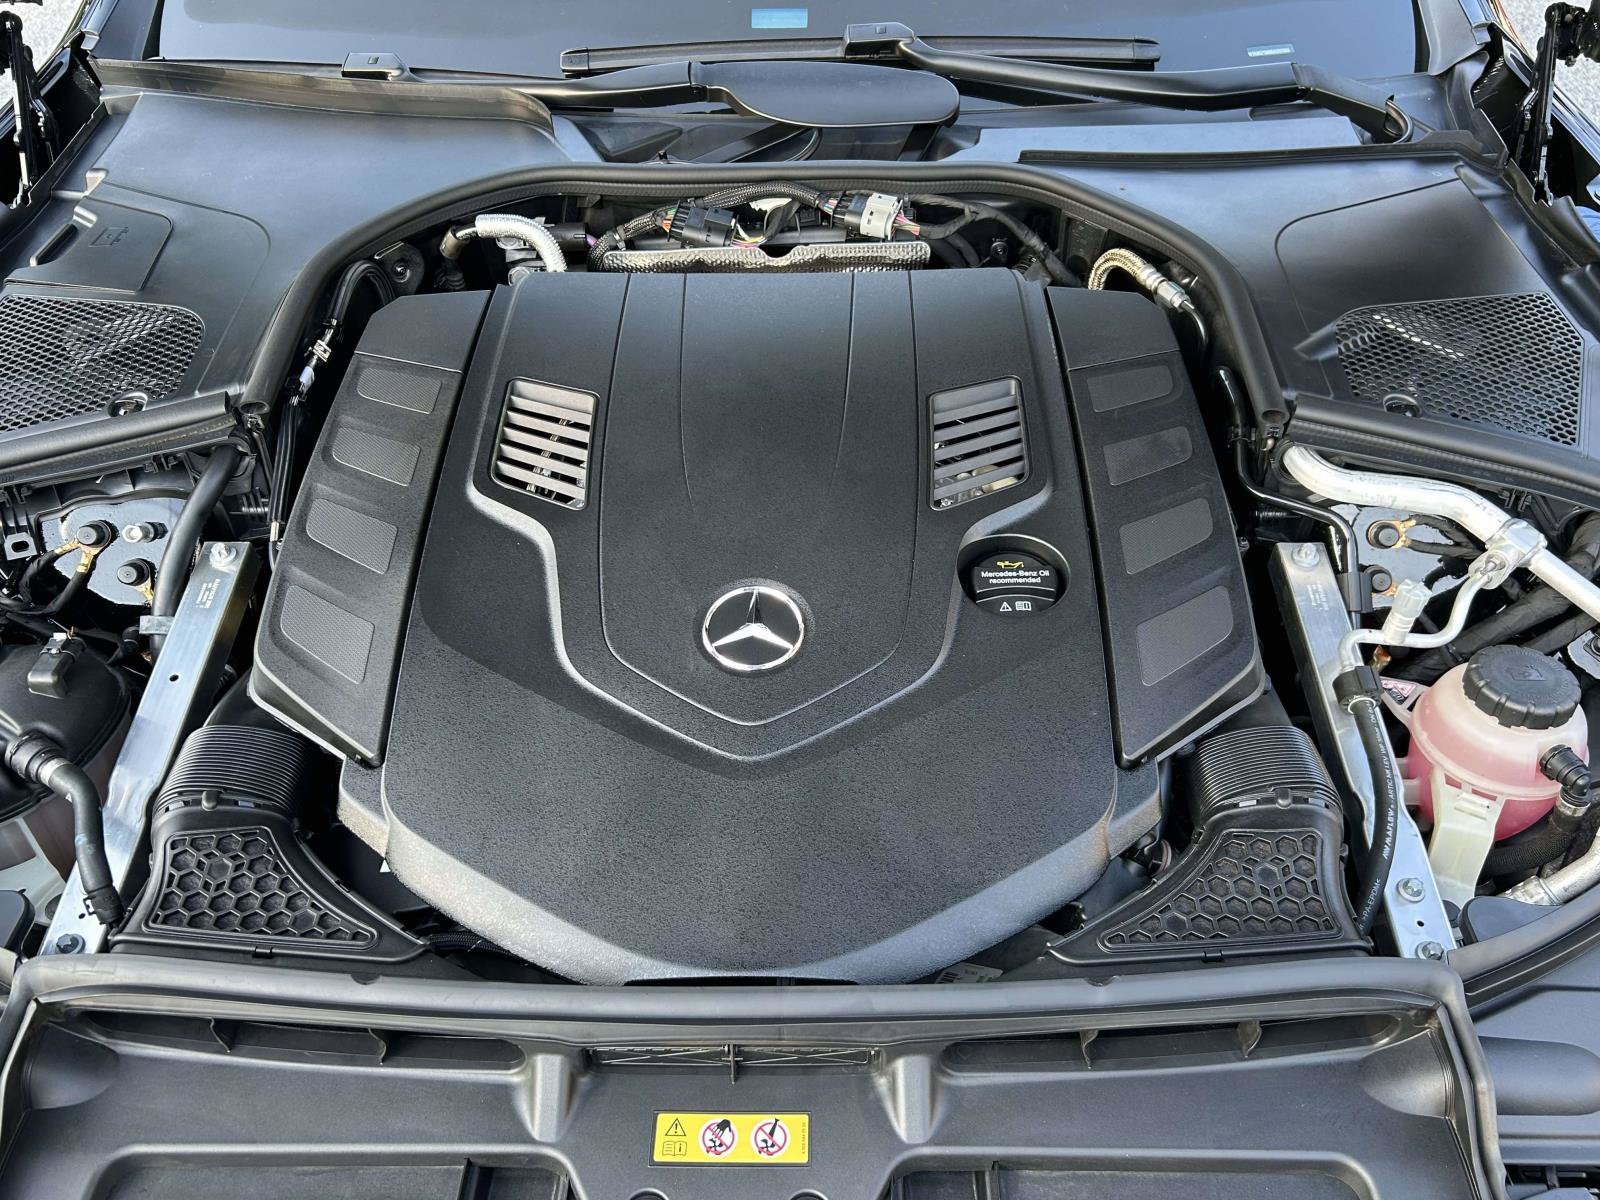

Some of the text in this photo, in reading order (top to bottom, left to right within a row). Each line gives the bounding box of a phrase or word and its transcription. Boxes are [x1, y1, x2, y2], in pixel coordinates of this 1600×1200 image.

[981, 569, 1050, 578] Mercedes-Benz Oil
[989, 576, 1041, 584] recommended
